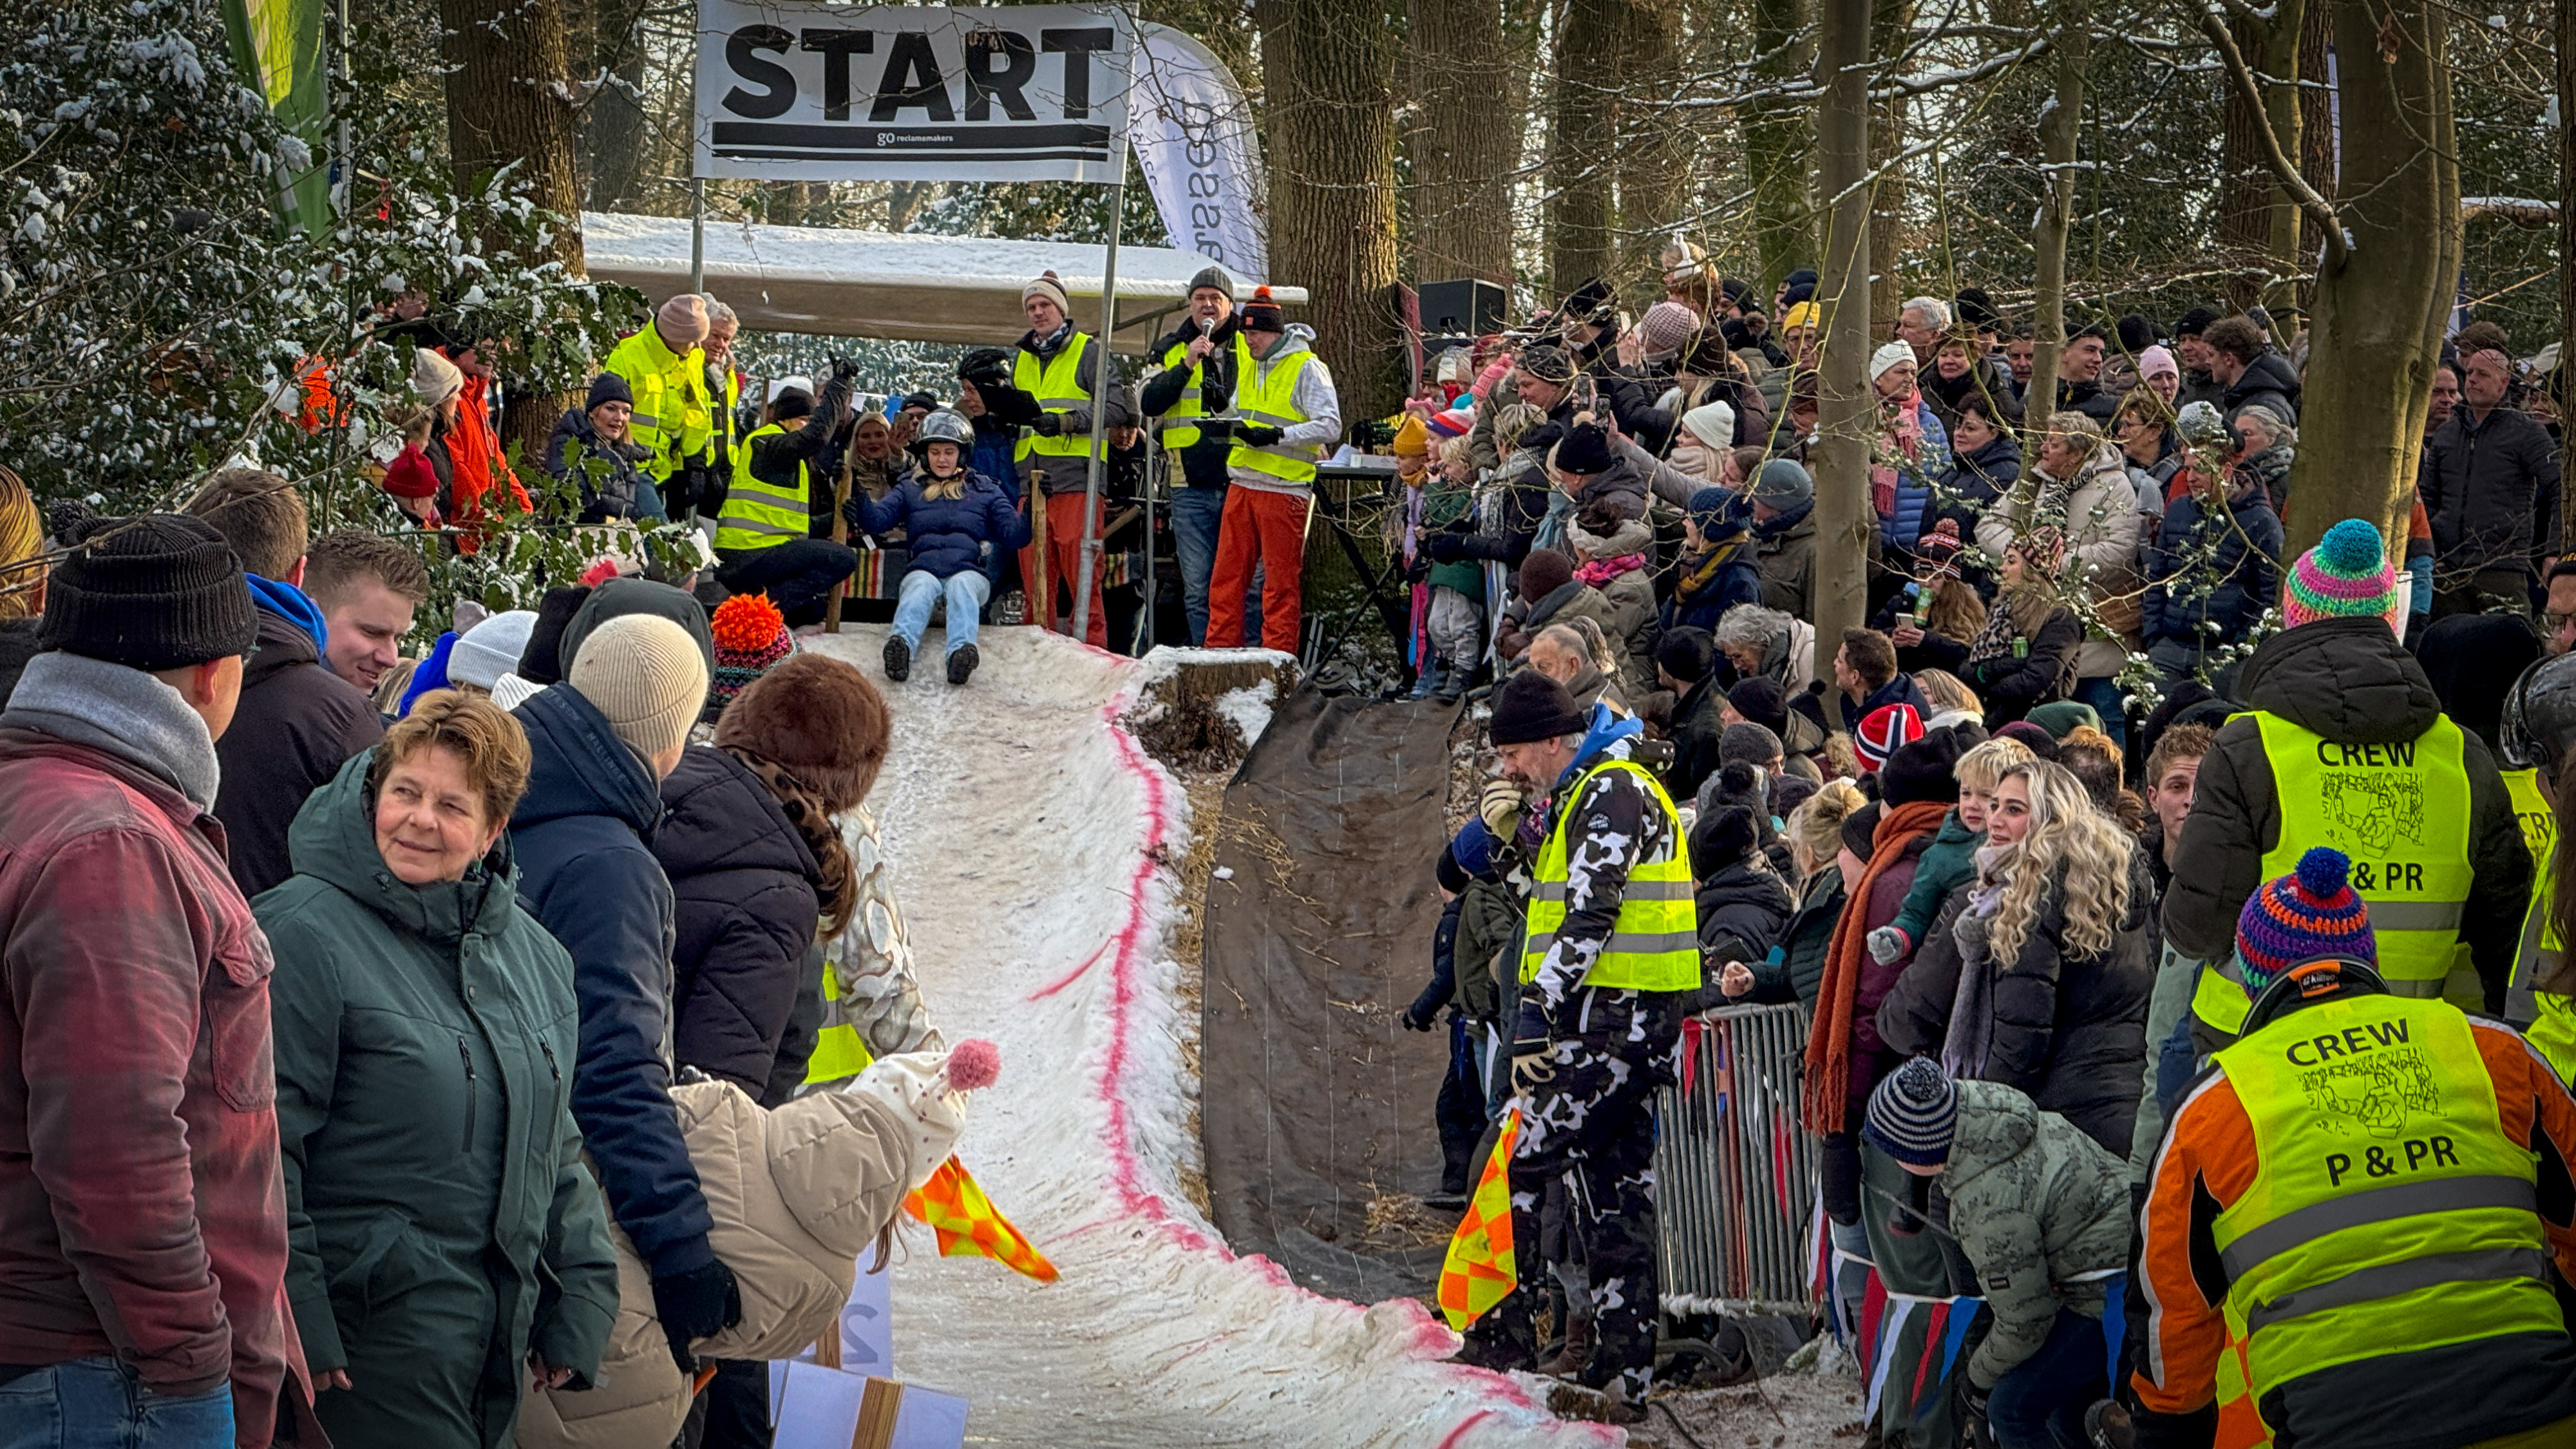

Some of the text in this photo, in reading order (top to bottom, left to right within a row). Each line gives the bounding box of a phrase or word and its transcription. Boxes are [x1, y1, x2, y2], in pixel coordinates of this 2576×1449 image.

[721, 23, 1114, 122] START
[876, 132, 895, 147] go
[2316, 739, 2416, 768] CREW
[2516, 812, 2553, 840] CR
[2353, 862, 2424, 891] & PR
[2286, 1018, 2410, 1066] CREW
[2325, 1135, 2460, 1188] P & PR
